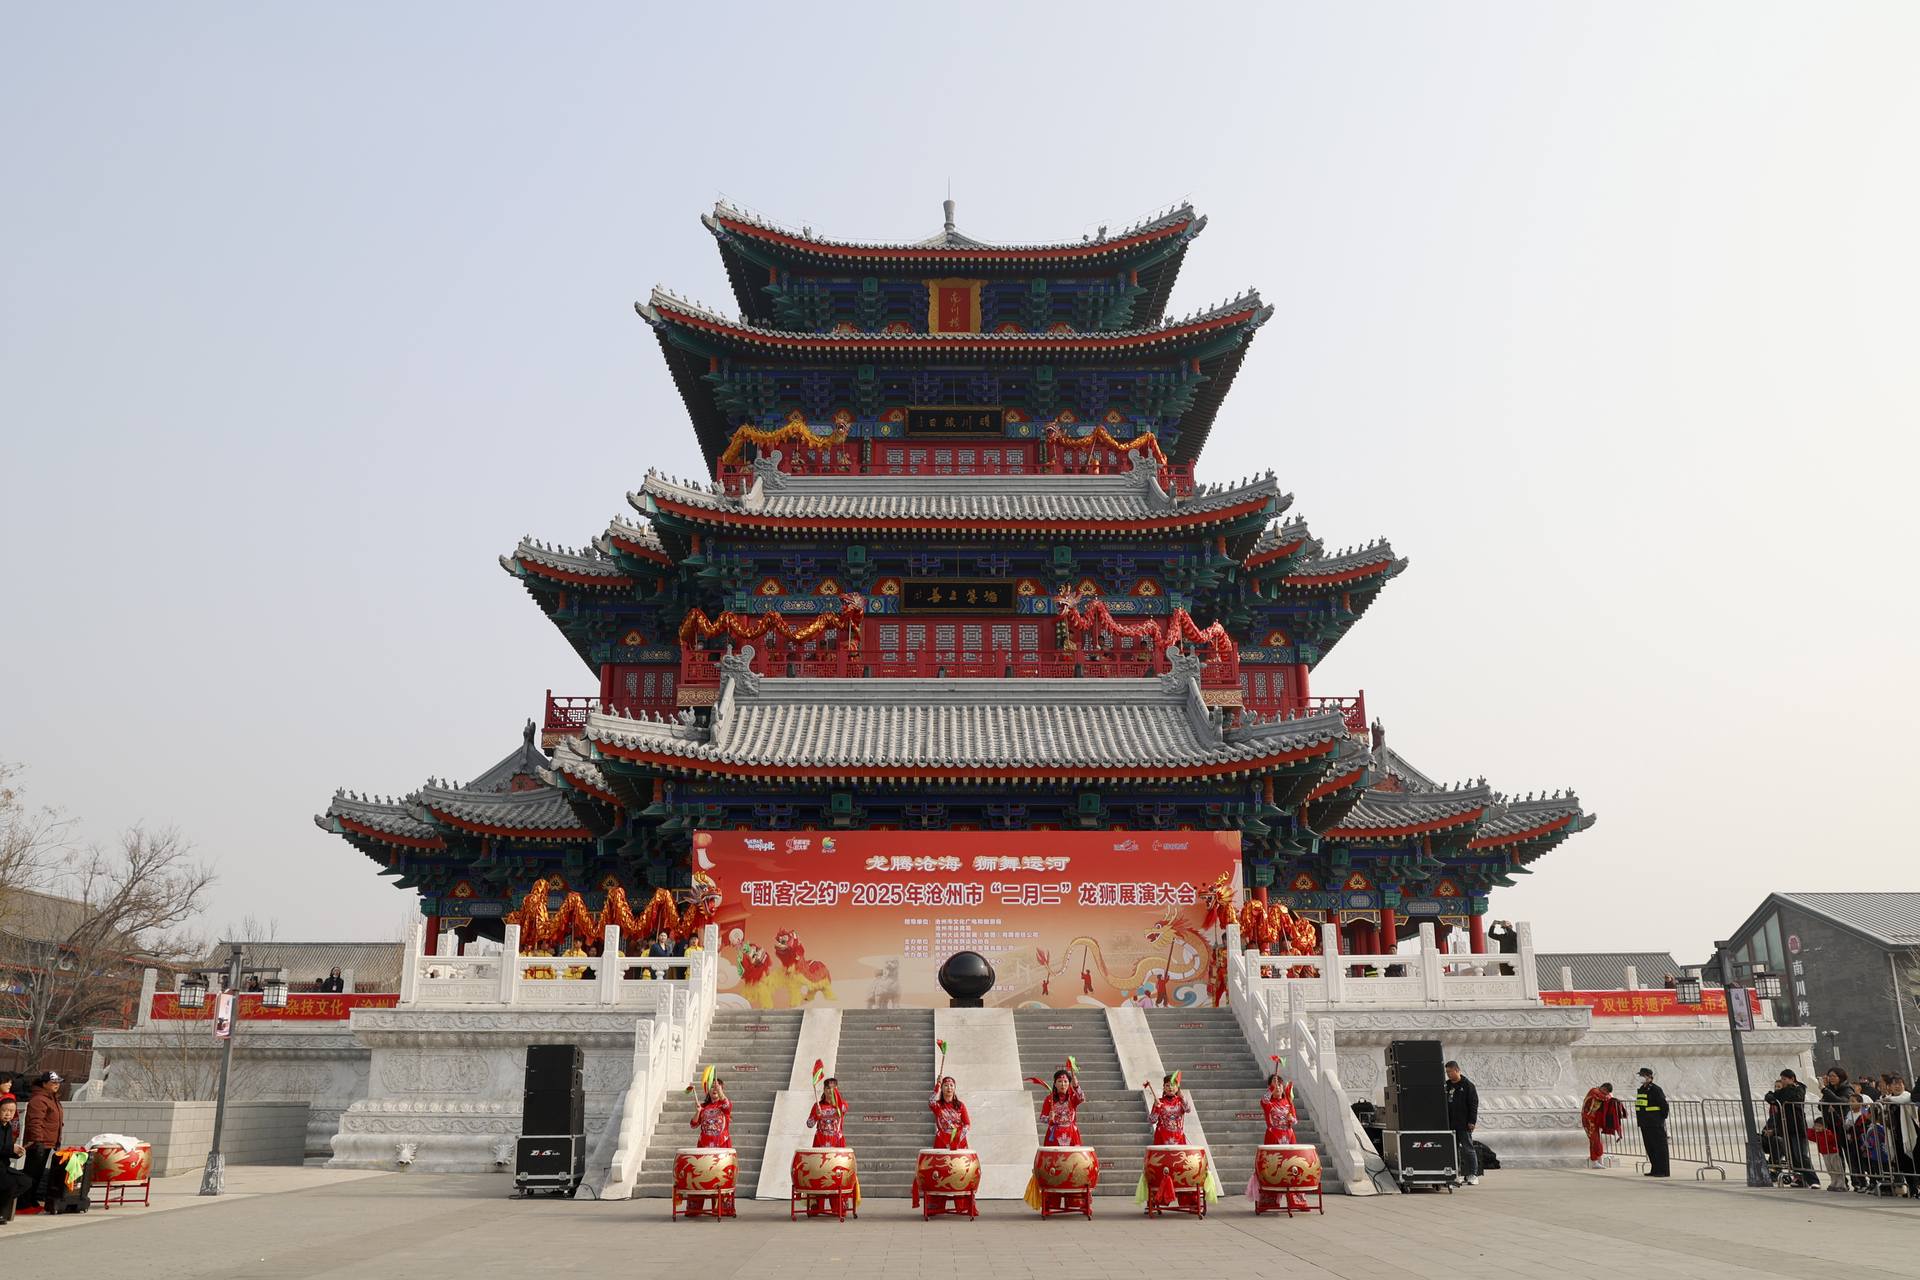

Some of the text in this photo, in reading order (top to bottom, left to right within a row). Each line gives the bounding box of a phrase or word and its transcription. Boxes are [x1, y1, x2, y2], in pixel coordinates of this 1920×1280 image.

[865, 855, 1070, 872] 龙腾沧海 狮舞运河
[1792, 959, 1811, 1026] 南川烤
